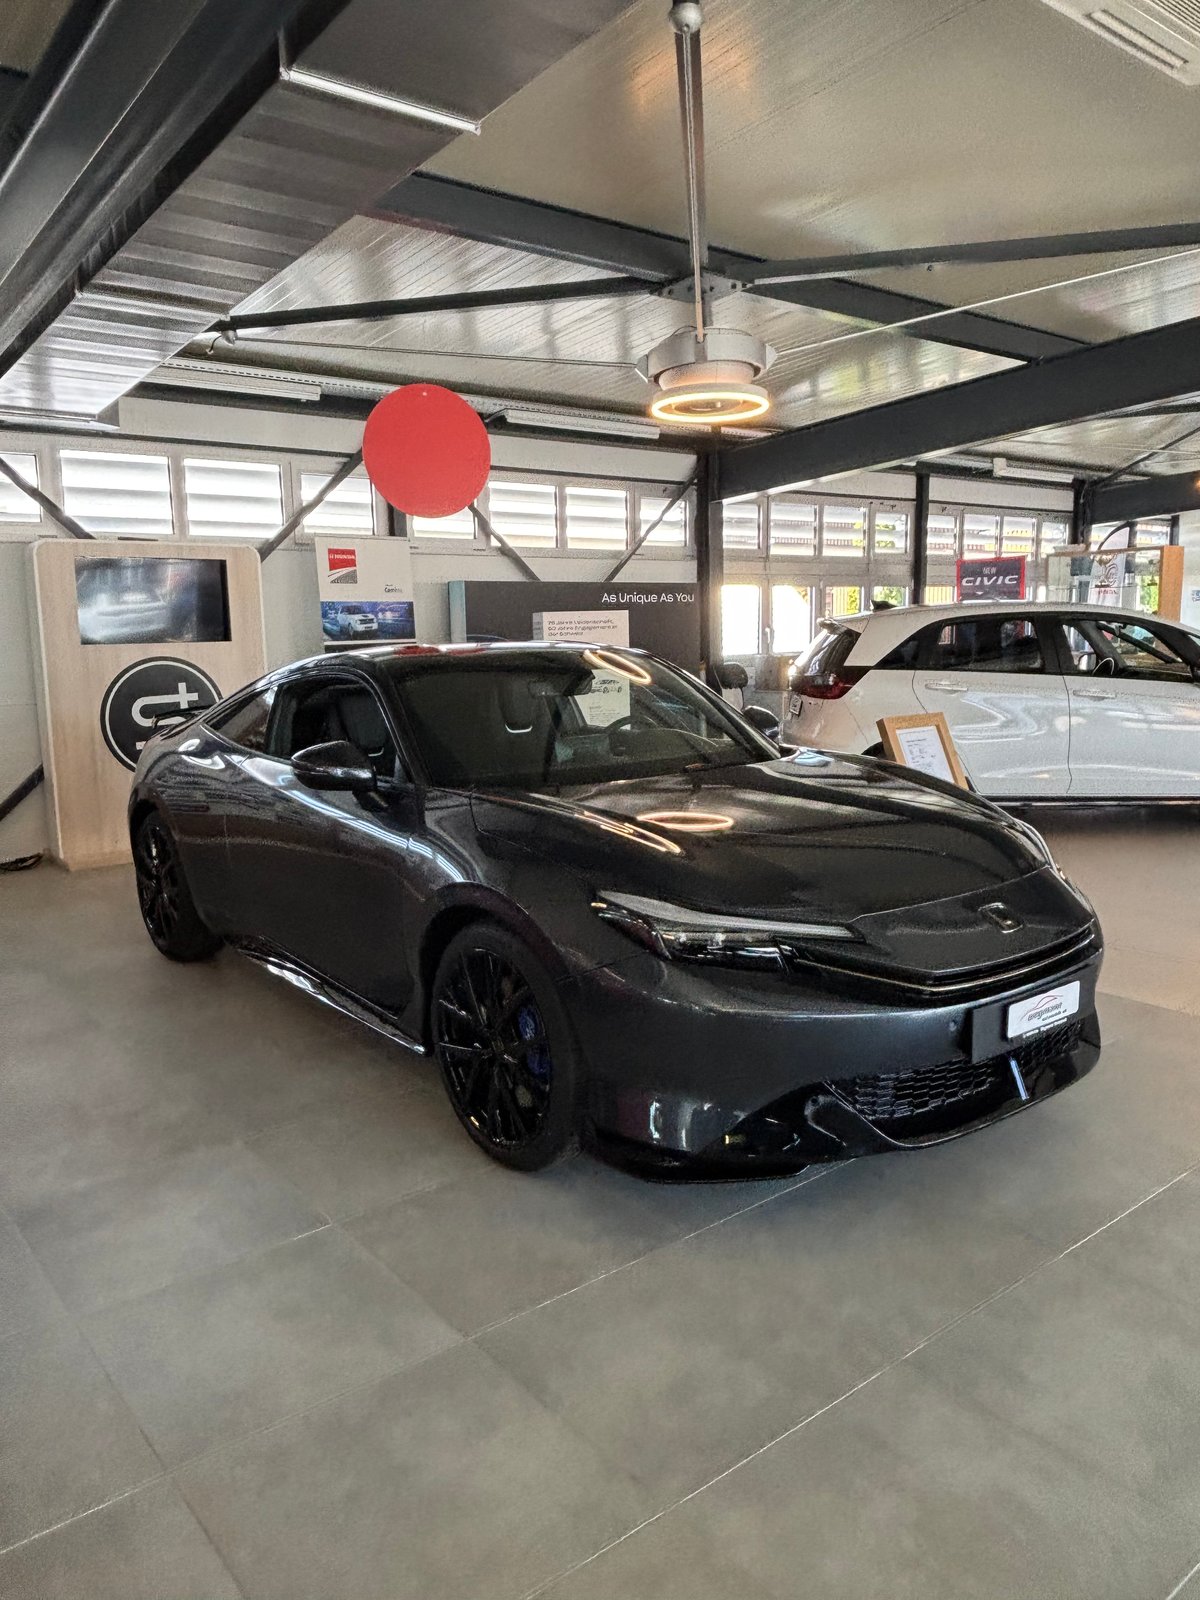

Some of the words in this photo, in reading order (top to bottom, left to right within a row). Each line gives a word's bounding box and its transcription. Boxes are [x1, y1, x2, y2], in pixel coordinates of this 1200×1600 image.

[962, 575, 1018, 586] CIVIC
[602, 592, 616, 602] As
[619, 592, 658, 604] Unique
[660, 592, 674, 602] As
[676, 592, 694, 602] You
